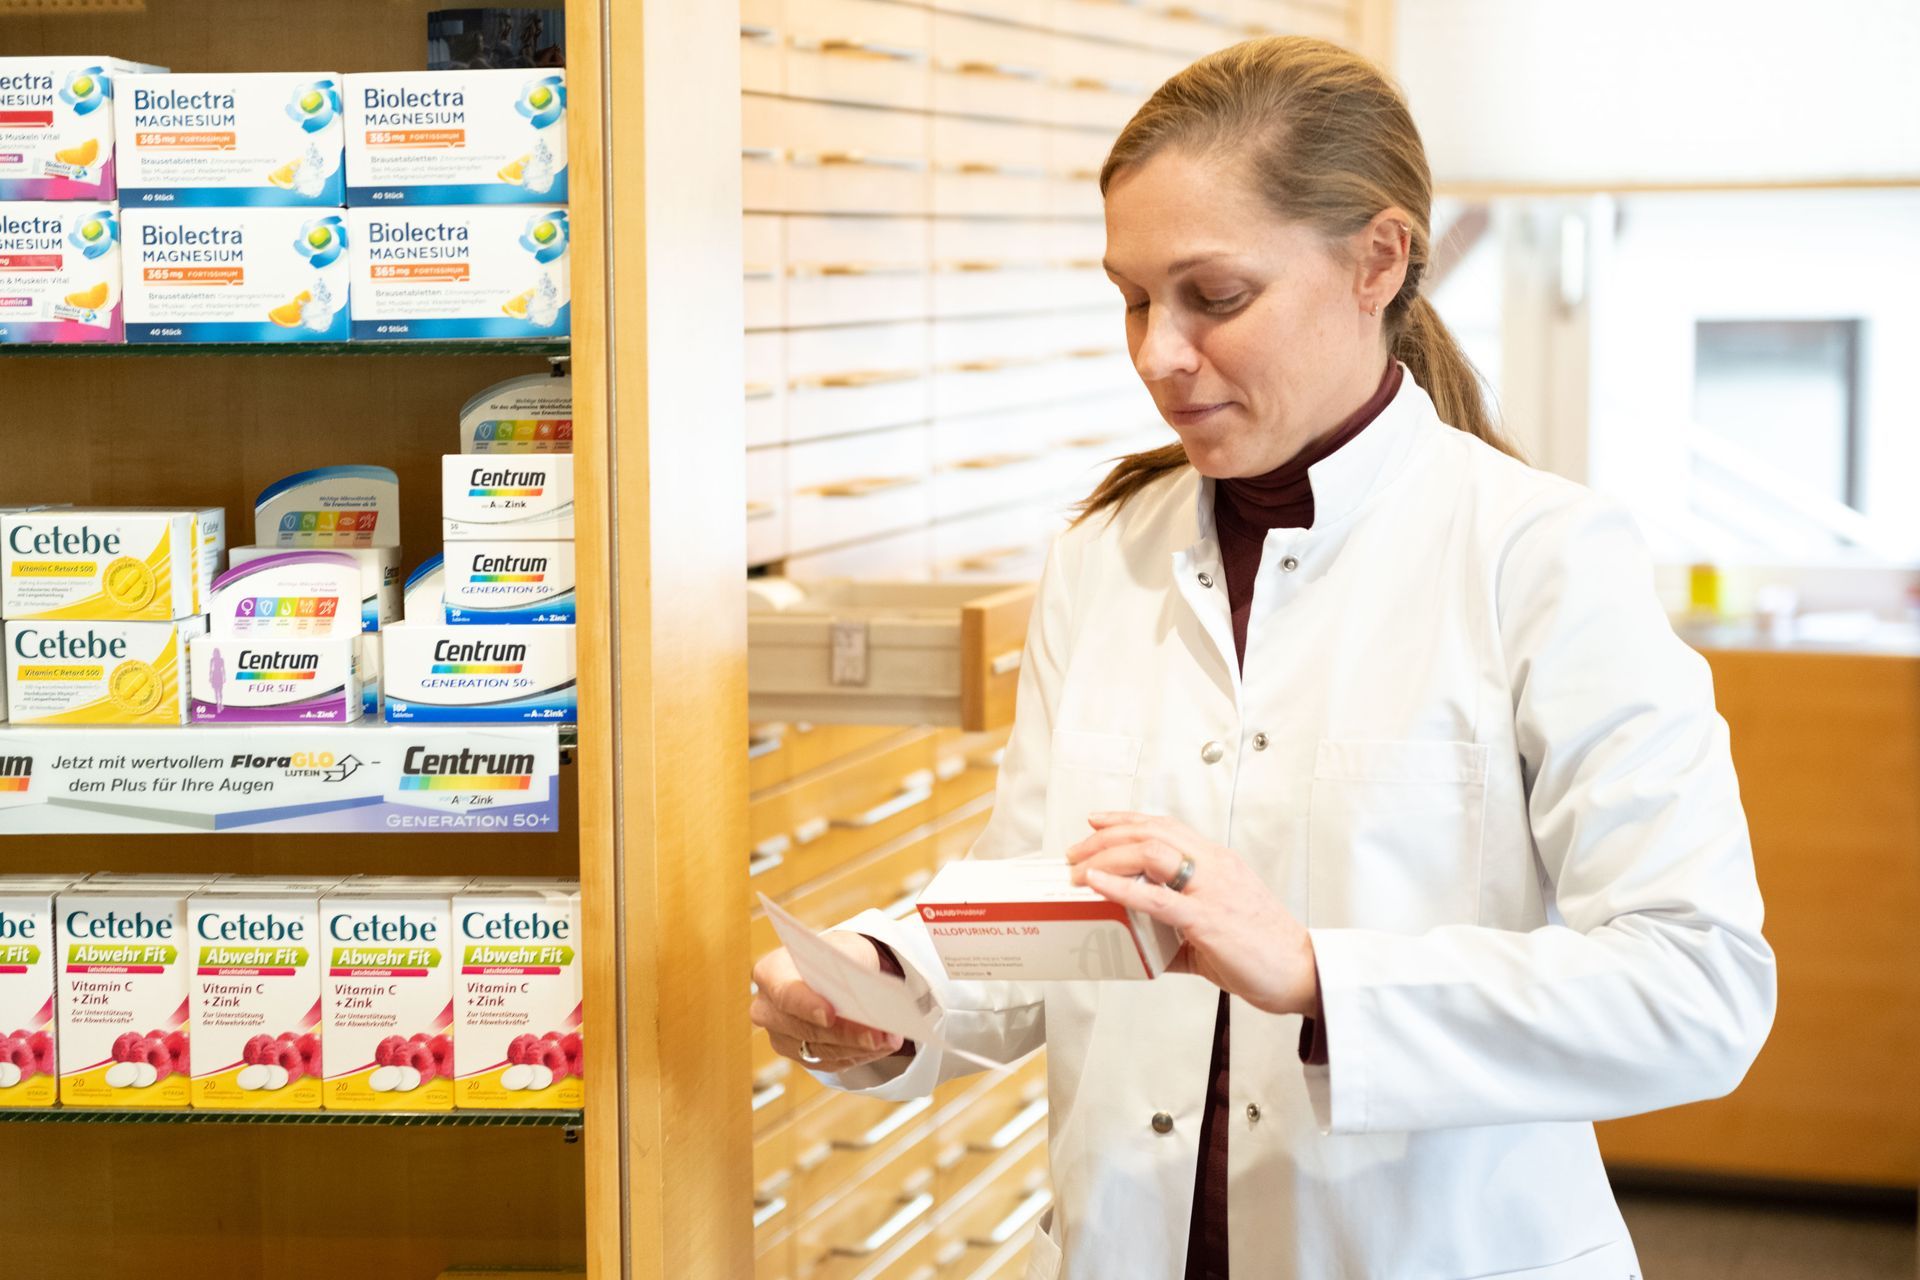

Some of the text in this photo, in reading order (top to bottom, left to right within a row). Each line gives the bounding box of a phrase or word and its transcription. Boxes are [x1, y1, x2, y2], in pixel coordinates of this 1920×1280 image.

[135, 90, 234, 110] Biolectra
[365, 87, 464, 108] Biolectra
[135, 115, 235, 126] MAGNESIUM
[365, 112, 465, 126] MAGNESIUM
[154, 193, 174, 201] Stück
[0, 216, 62, 234] lectra
[143, 225, 242, 245] Biolectra
[369, 223, 468, 243] Biolectra
[0, 239, 62, 250] NESIUM
[143, 250, 243, 262] MAGNESIUM
[370, 246, 469, 259] MAGNESIUM
[161, 328, 182, 336] Stück
[389, 325, 408, 333] Stück
[471, 468, 546, 487] Centrum
[10, 525, 120, 554] Cetebe
[473, 554, 547, 573] Centrum
[462, 586, 555, 594] GENERATION 50+
[15, 629, 126, 658] Cetebe
[434, 640, 526, 662] Centrum
[239, 651, 319, 670] Centrum
[249, 683, 296, 692] FÜR SIE
[421, 679, 535, 688] GENERATION 50+
[392, 704, 406, 712] 100
[51, 752, 335, 769] Jetzt mit wertvollem FloraGLO
[403, 746, 535, 775] Centrum
[69, 778, 274, 794] dem Plus für Ihre Augen
[451, 795, 494, 804] A Zink
[386, 814, 550, 828] GENERATION 50+
[66, 911, 172, 939] Cetebe
[197, 913, 304, 941] Cetebe
[330, 914, 436, 942] Cetebe
[462, 912, 569, 939] Cetebe
[933, 927, 1040, 936] ALLOPURINOL AL 300
[7, 947, 29, 961] Fit
[75, 947, 167, 963] Abwehr Fit
[206, 949, 298, 965] Abwehr Fit
[338, 950, 430, 965] Abwehr Fit
[470, 948, 563, 963] Abwehr Fit
[72, 981, 133, 992] Vitamin C
[203, 983, 264, 994] Vitamin C
[335, 984, 397, 995] Vitamin C
[467, 982, 529, 993] Vitamin C
[81, 994, 109, 1005] Zink
[213, 996, 240, 1007] Zink
[345, 998, 372, 1008] Zink
[477, 996, 504, 1006] Zink
[84, 1009, 133, 1018] Unterstützung
[215, 1011, 263, 1020] Unterstützung
[348, 1012, 396, 1021] Unterstützung
[480, 1010, 528, 1019] Unterstützung
[73, 1079, 85, 1087] 20
[204, 1081, 216, 1089] 20
[336, 1082, 348, 1091] 20
[468, 1081, 479, 1089] 20
